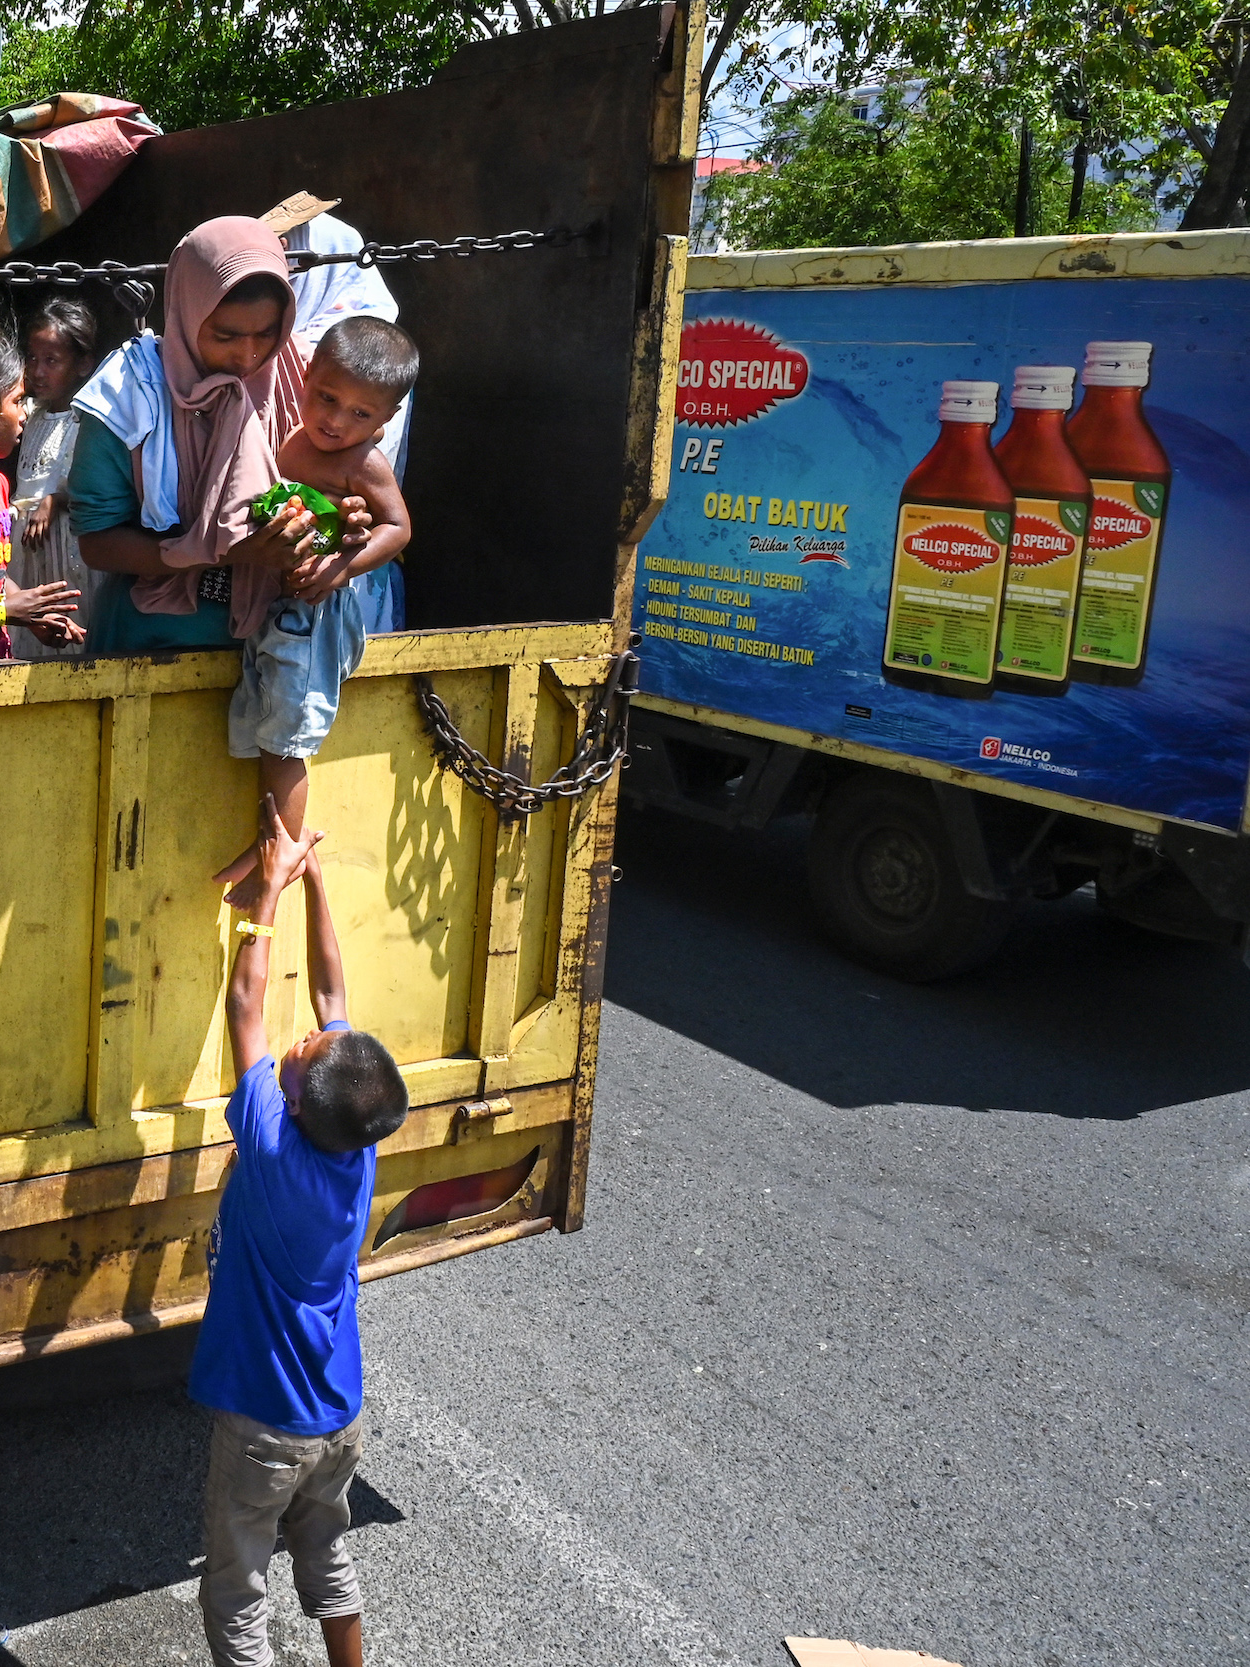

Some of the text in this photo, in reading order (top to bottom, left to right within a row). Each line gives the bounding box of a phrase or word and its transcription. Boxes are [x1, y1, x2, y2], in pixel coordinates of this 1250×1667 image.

[683, 401, 732, 417] O.B.H.
[679, 437, 724, 474] P.E
[703, 492, 849, 533] OBAT BATUK
[1093, 516, 1143, 534] SPECIAL
[749, 535, 846, 557] Pilihan Keluarga
[911, 538, 994, 560] NELLCO SPECIAL
[1022, 533, 1068, 552] SPECIAL
[644, 556, 706, 578] MERINGANKAN
[708, 565, 741, 584] GEJALA
[744, 570, 761, 586] FLU
[763, 572, 803, 592] SEPERTI
[648, 578, 680, 596] DEMAM
[688, 584, 714, 602] SAKIT
[715, 589, 751, 608] KEPALA
[646, 599, 677, 618] HIDUNG
[679, 605, 732, 627] TERSUMBAT
[736, 614, 757, 631] DAN
[645, 622, 709, 646] BERSIN-BERSIN
[711, 633, 735, 651] YANG
[737, 638, 780, 659] DISERTAI
[782, 646, 815, 666] BATUK
[1002, 743, 1051, 762] NELLCO
[999, 755, 1032, 767] JAKARTA
[1037, 762, 1079, 777] INDONESIA
